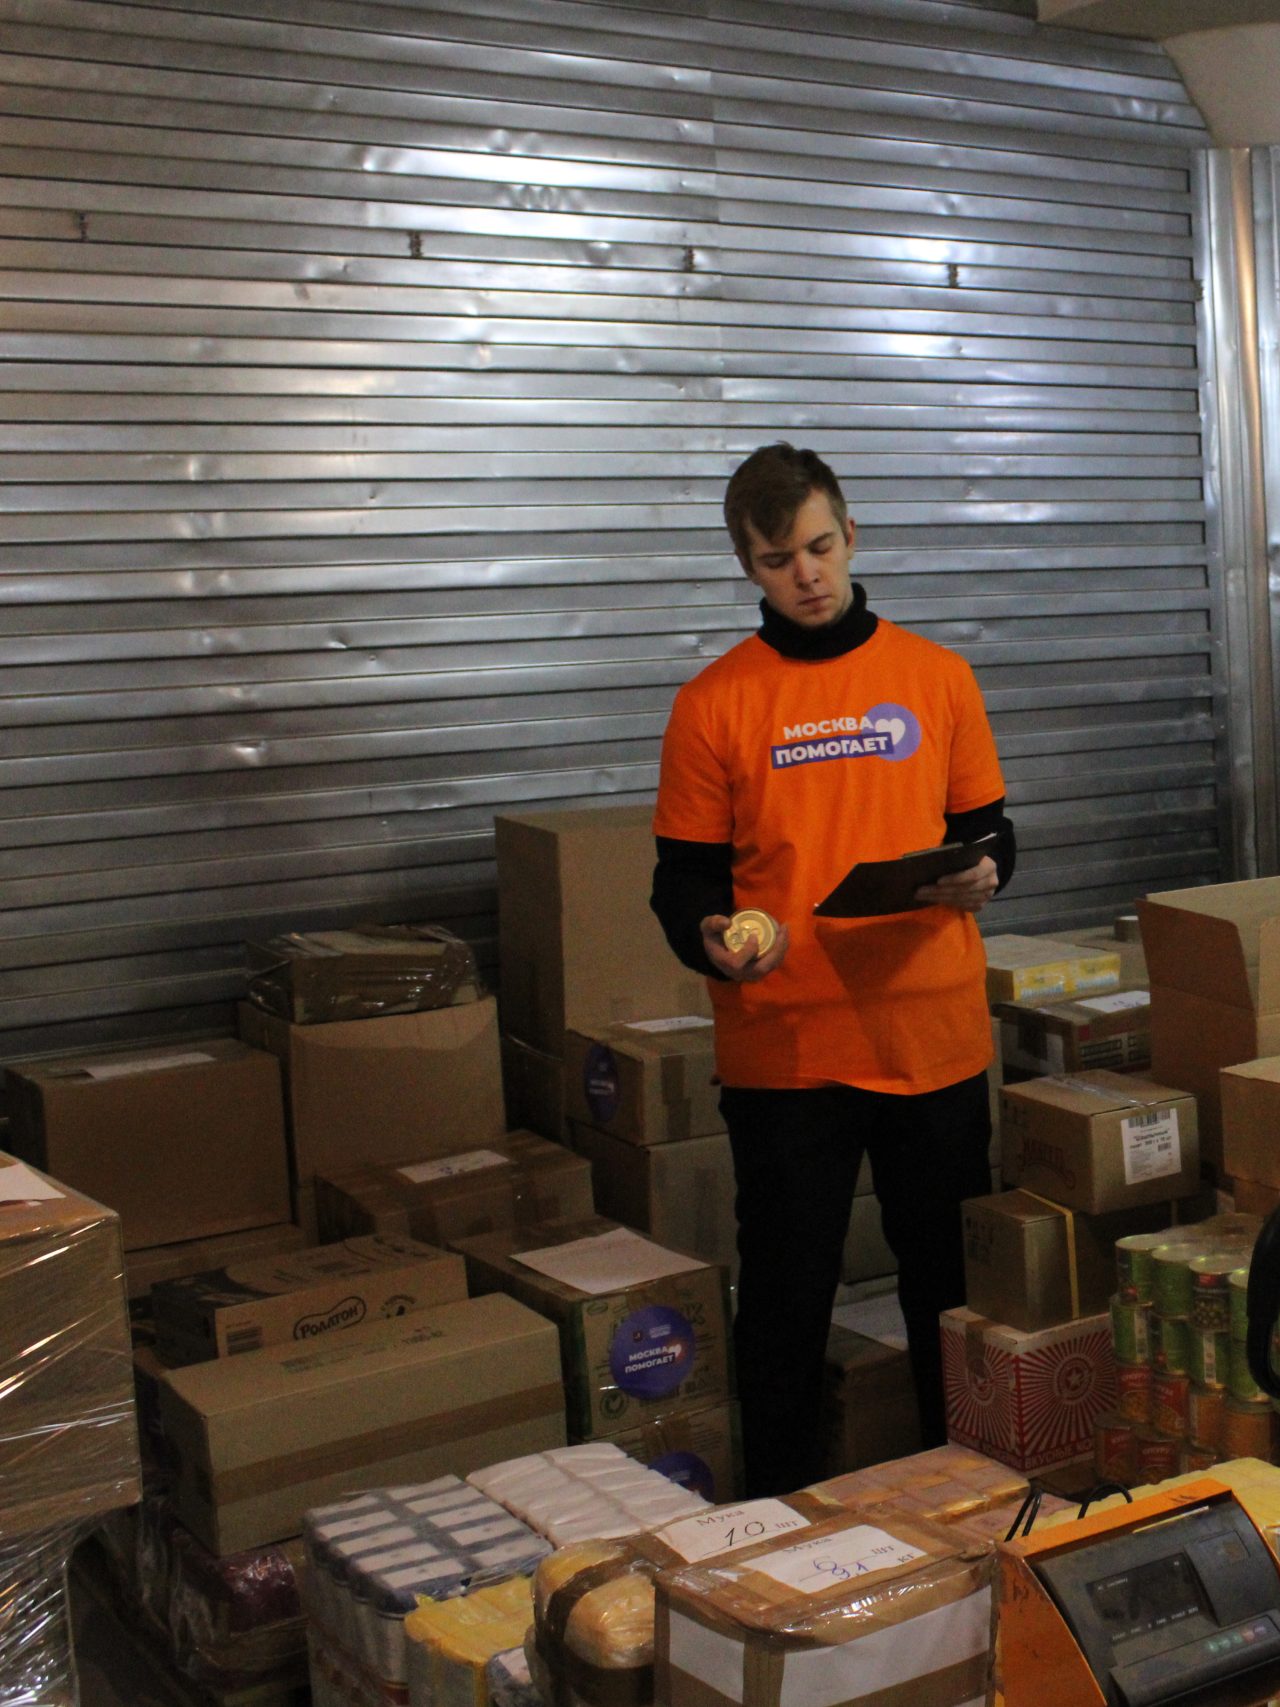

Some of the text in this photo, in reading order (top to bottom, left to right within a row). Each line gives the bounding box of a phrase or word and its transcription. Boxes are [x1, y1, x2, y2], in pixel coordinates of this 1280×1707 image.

[783, 716, 875, 740] МОСКВА
[775, 736, 888, 765] ПОМОГАЕТ
[624, 1355, 674, 1374] ПОМОГАЕТ
[629, 1346, 670, 1362] МОСКВА
[696, 1509, 745, 1527] Мука
[725, 1521, 765, 1547] 10
